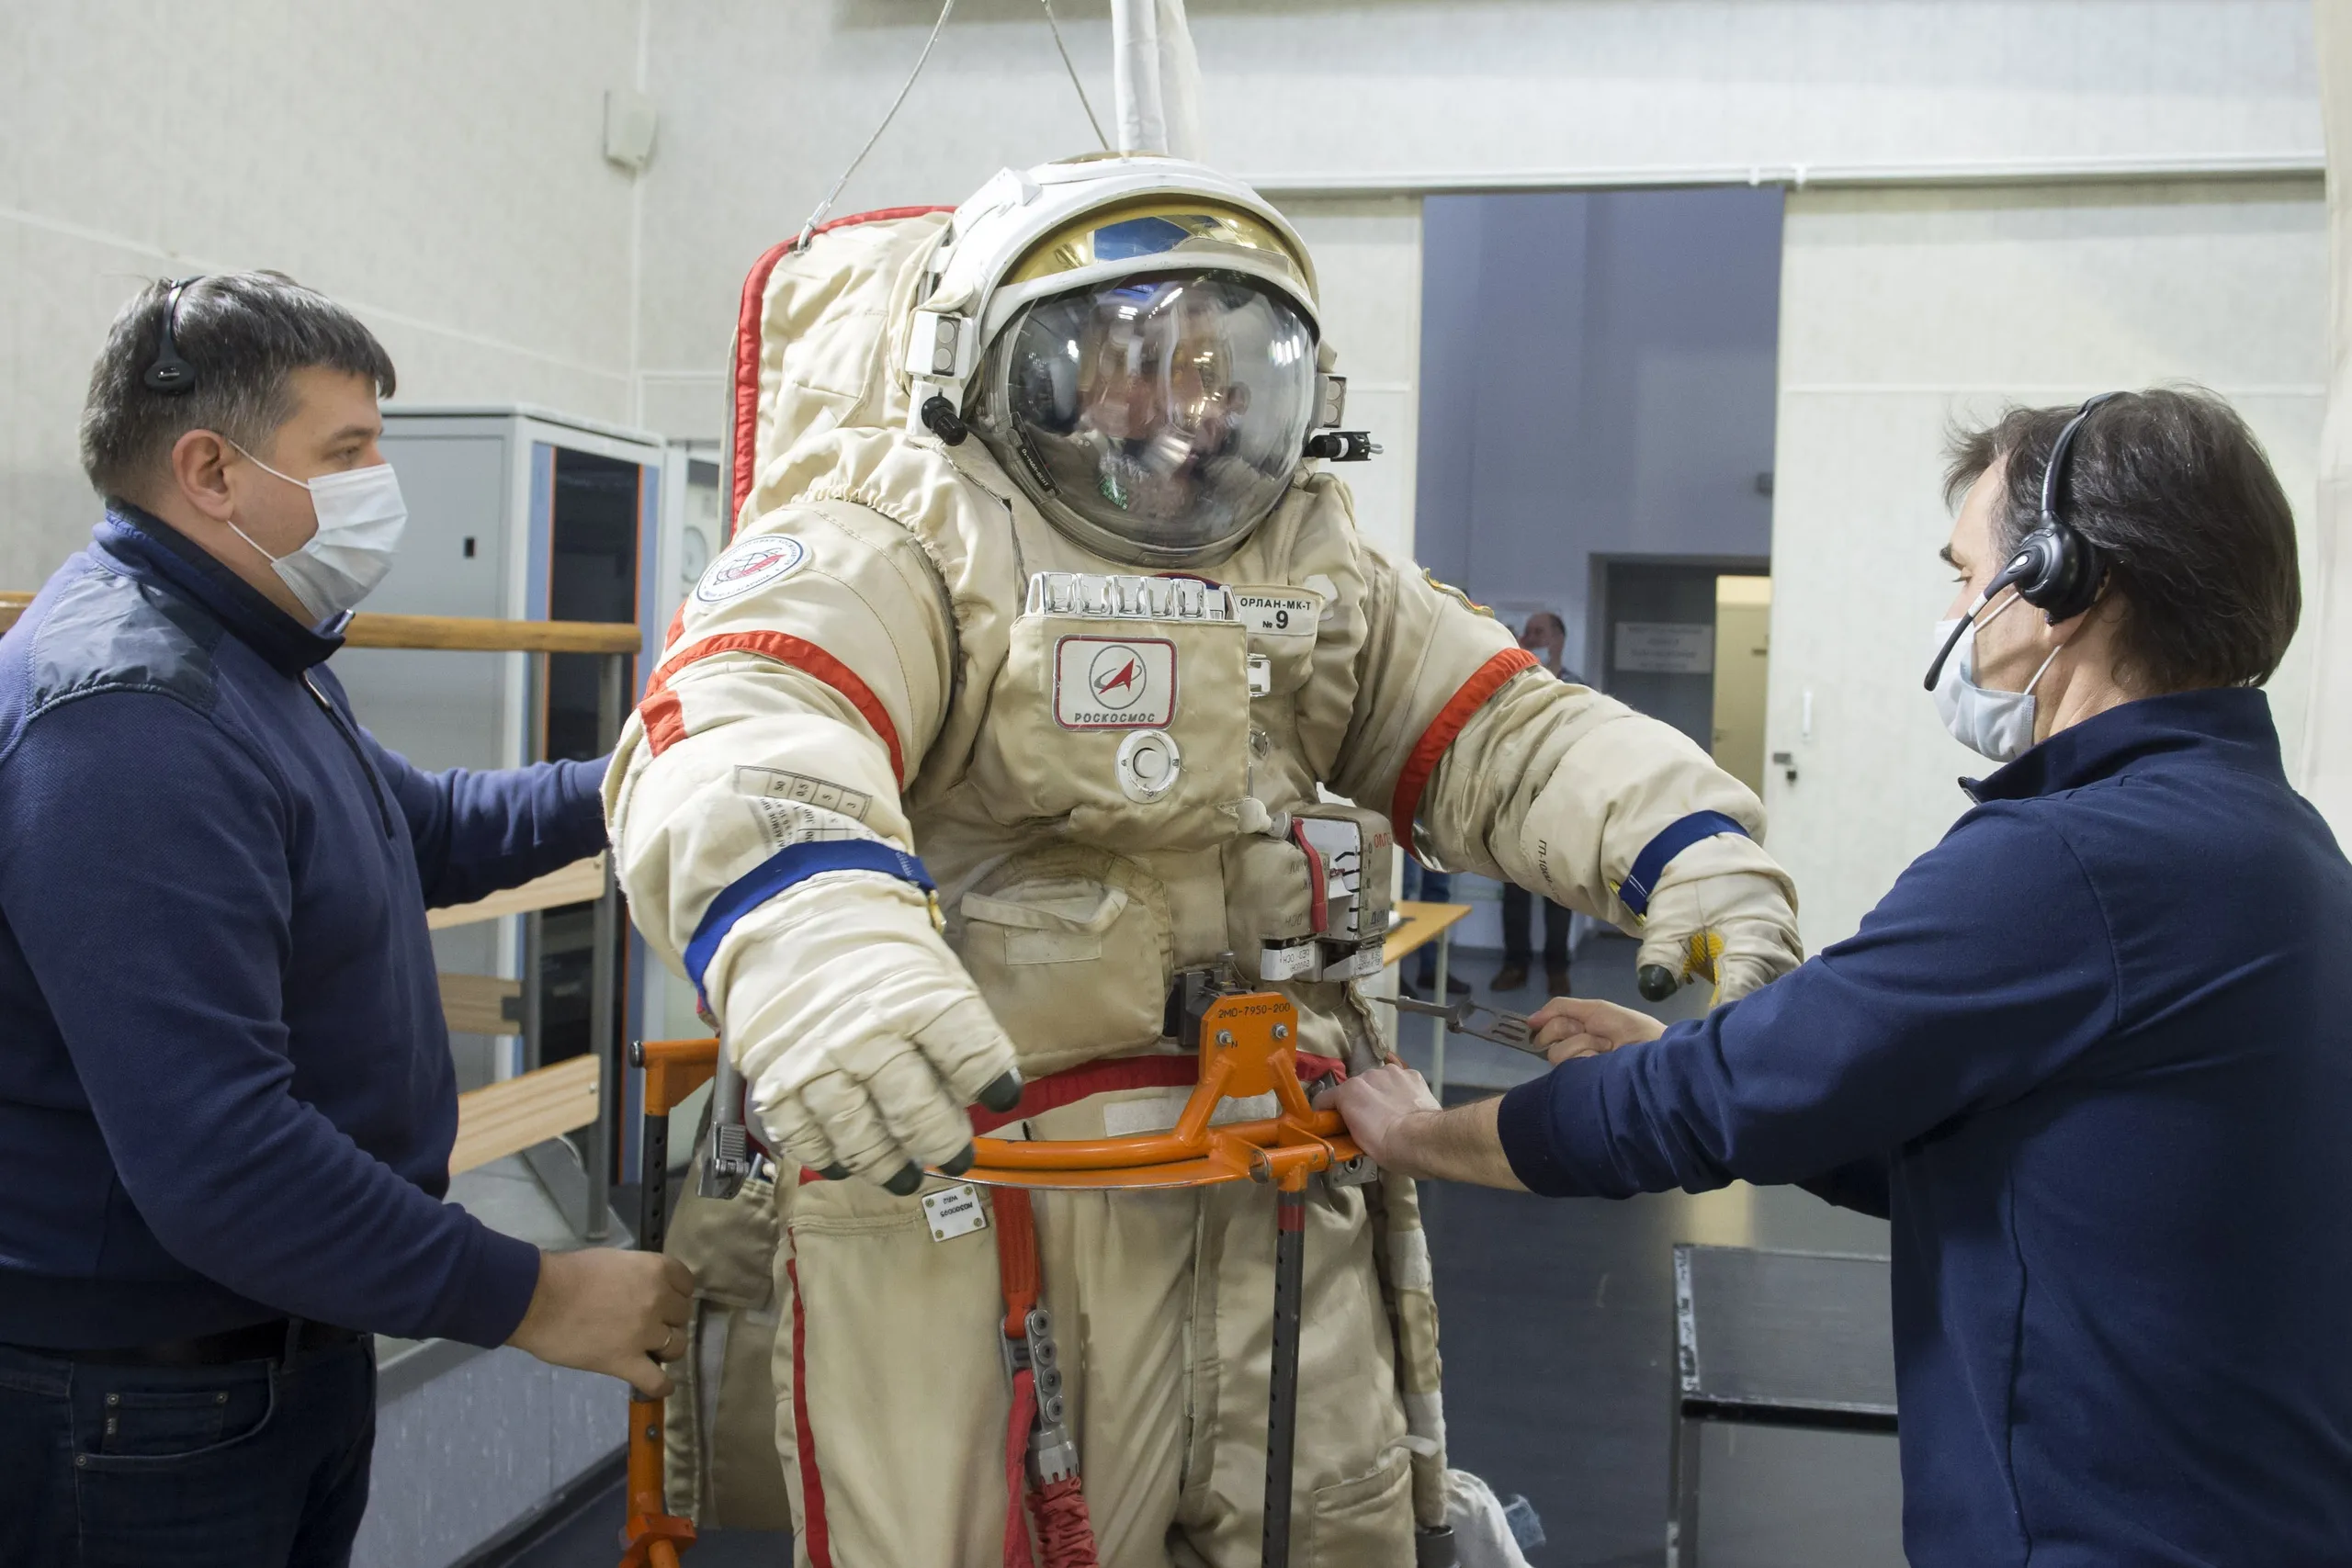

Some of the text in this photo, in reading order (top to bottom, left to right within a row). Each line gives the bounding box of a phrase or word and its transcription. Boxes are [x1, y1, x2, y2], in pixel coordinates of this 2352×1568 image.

[1240, 598, 1311, 612] ОРЛАН-МК-Т
[1262, 610, 1289, 630] № 9
[1074, 713, 1155, 724] РОСКОСМОС
